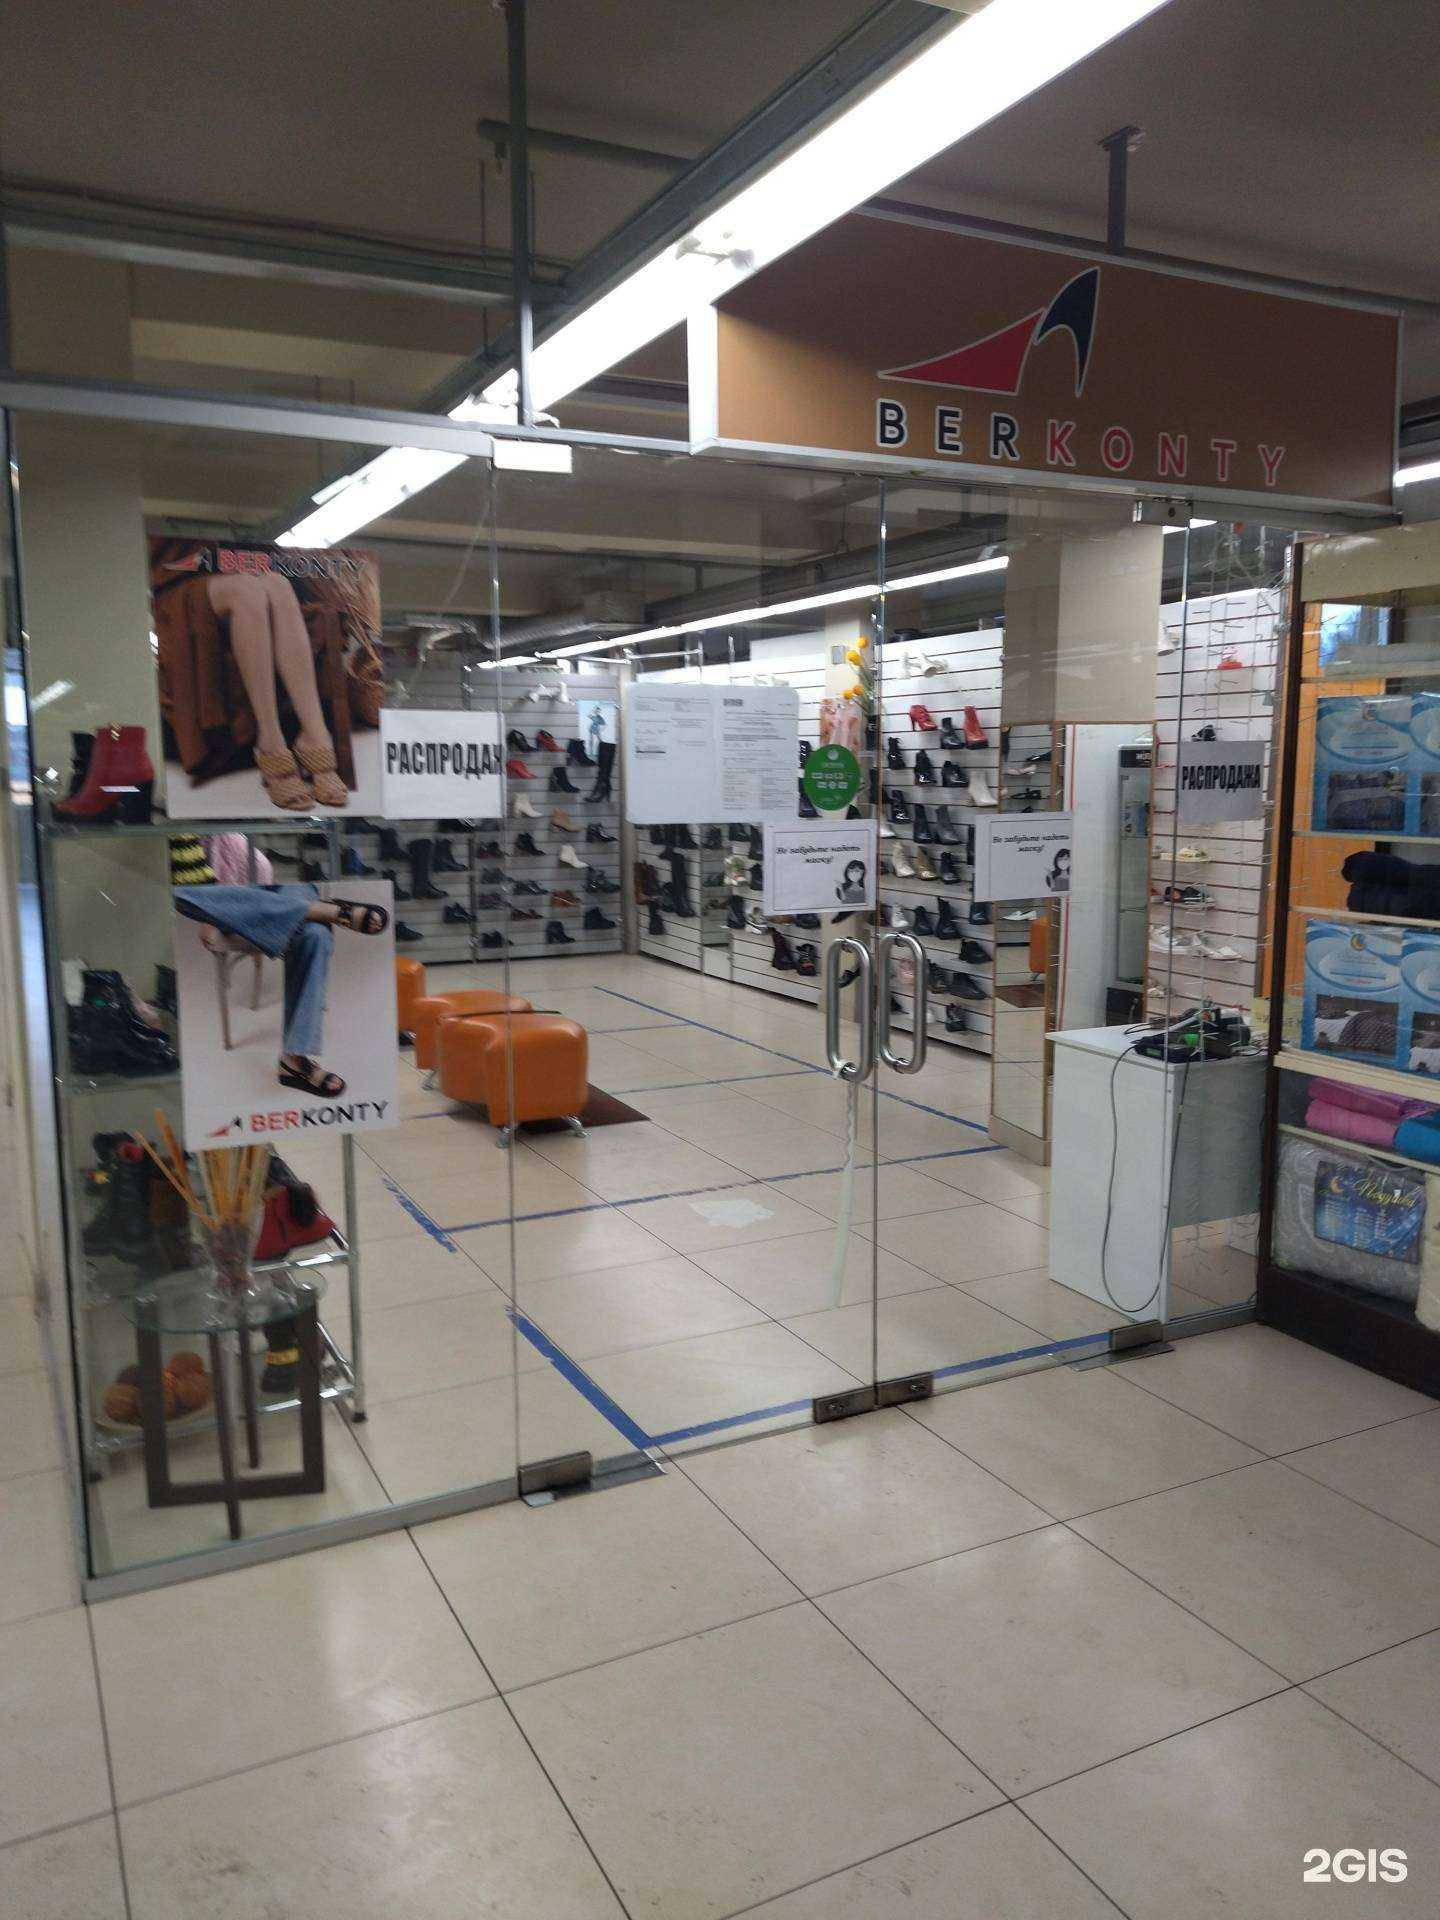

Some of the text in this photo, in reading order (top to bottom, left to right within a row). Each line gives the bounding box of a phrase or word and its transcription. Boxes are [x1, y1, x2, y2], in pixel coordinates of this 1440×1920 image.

[875, 397, 1286, 487] BERKONTY
[216, 550, 367, 579] BERKONTY
[1181, 764, 1261, 793] РАСПРОДАЖА
[250, 1100, 389, 1132] BERKONTY
